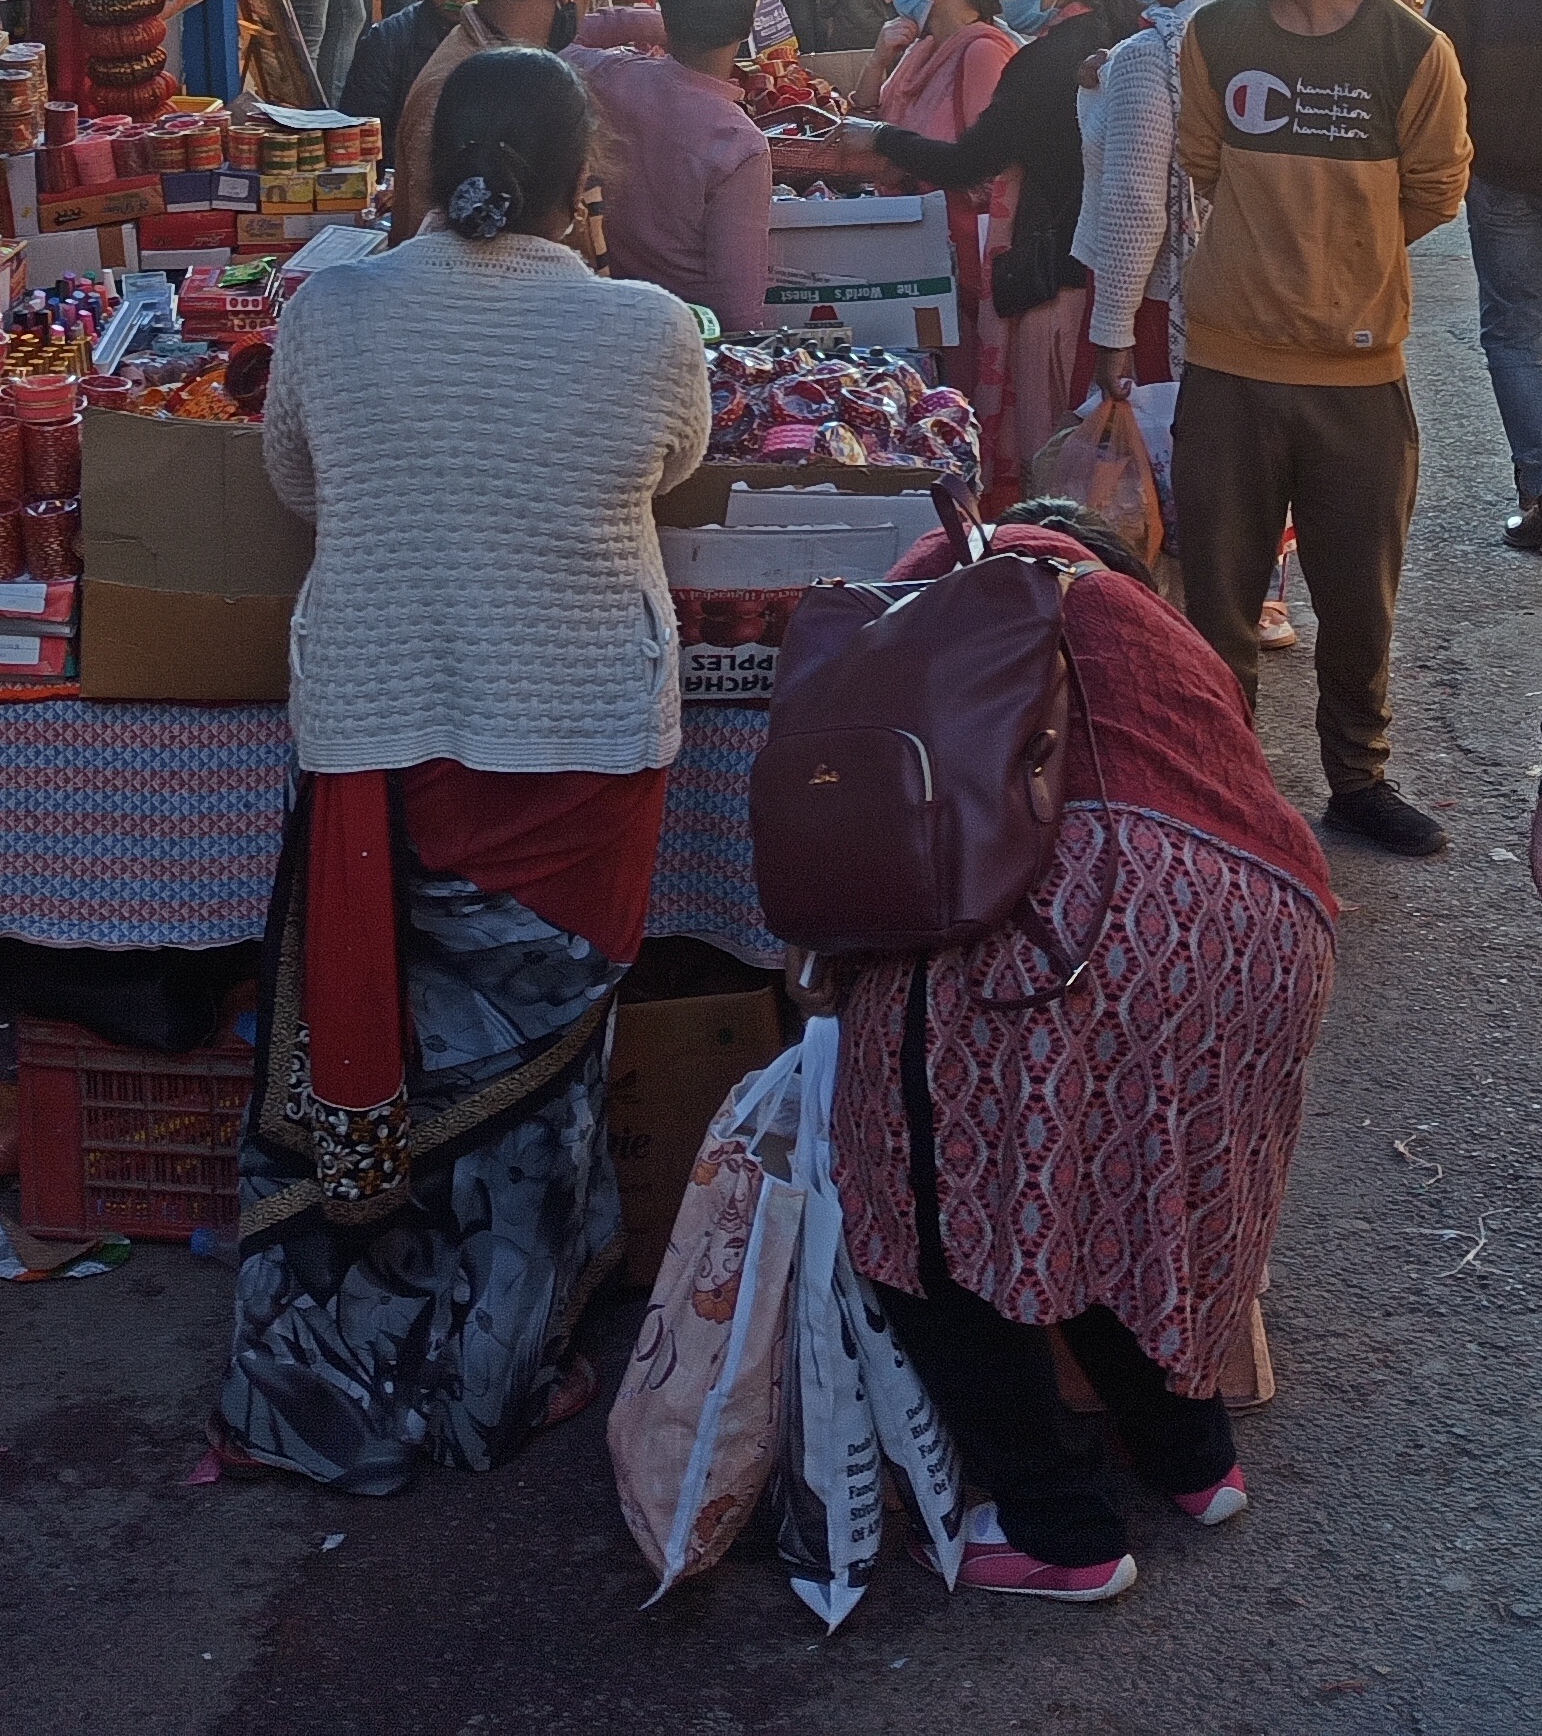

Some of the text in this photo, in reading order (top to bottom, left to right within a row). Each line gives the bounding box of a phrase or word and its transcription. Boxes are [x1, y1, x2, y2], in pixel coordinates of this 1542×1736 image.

[780, 283, 919, 303] The World's Finest
